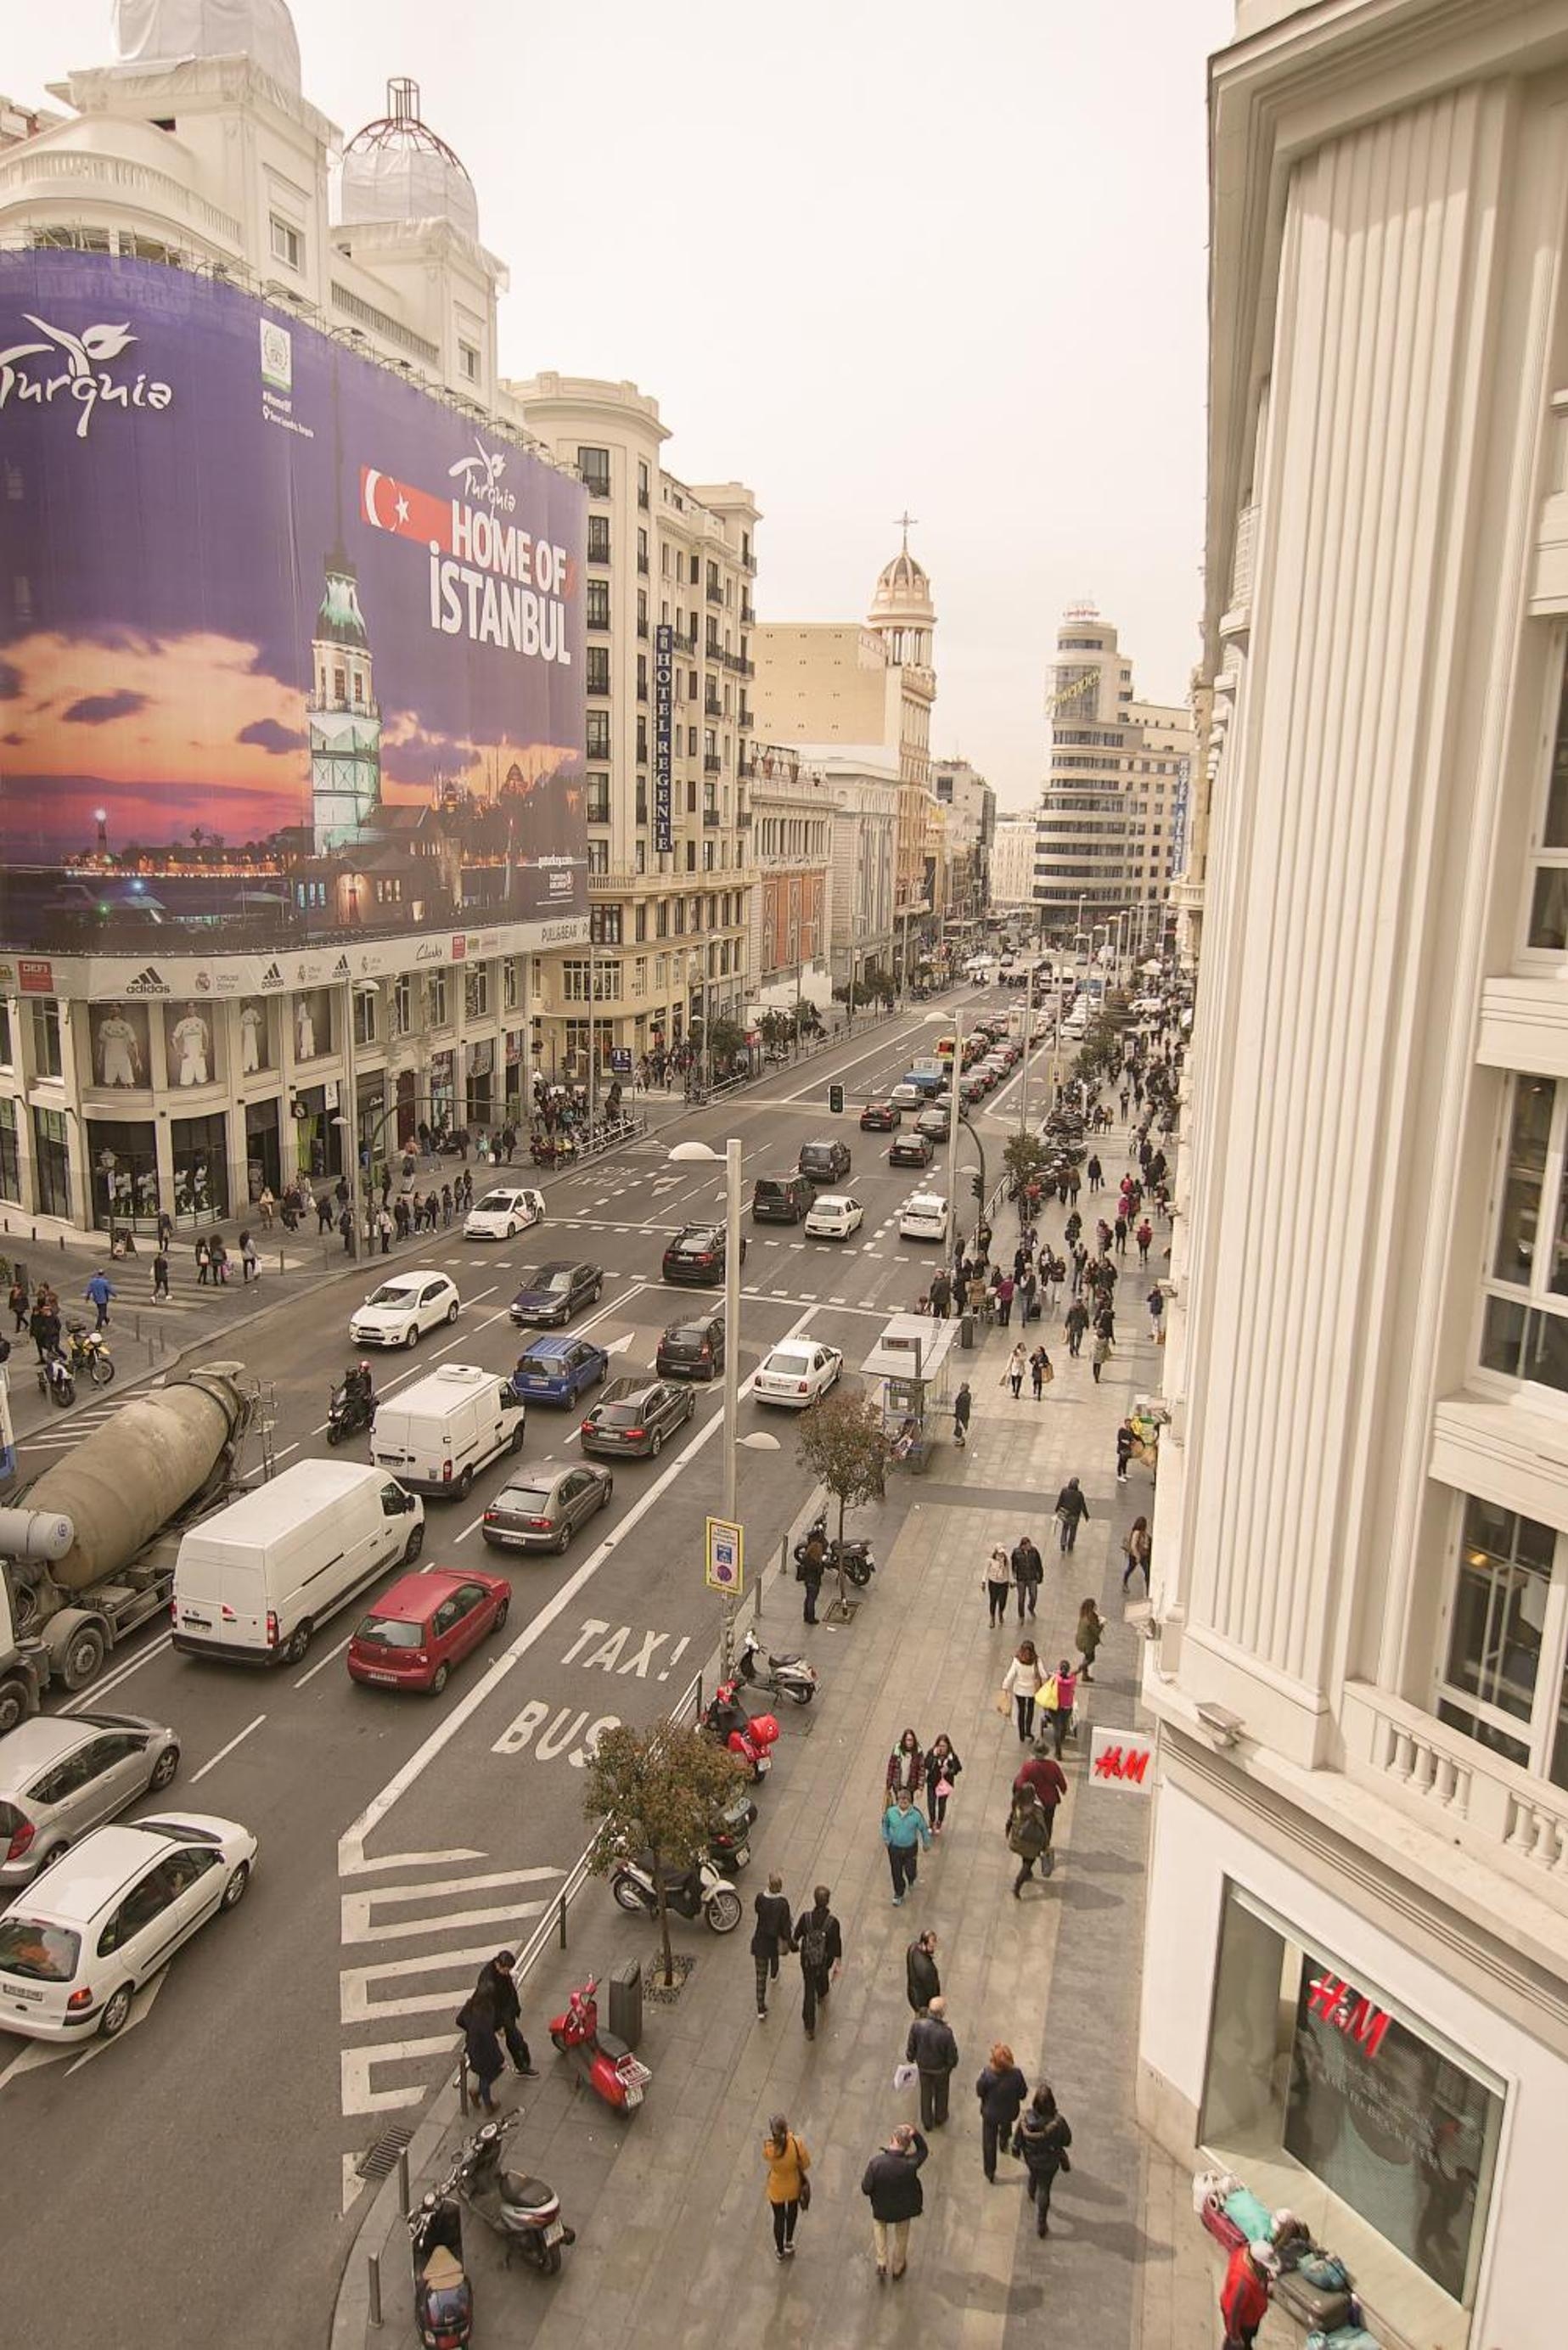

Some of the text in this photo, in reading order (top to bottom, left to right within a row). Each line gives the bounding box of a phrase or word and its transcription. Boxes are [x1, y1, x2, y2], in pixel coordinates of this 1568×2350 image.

[452, 499, 566, 596] HOME OF
[657, 652, 671, 851] HOTEL REGENTE
[126, 983, 171, 994] adidas
[261, 978, 284, 989] adidas
[490, 1700, 622, 1768] BUS
[1094, 1746, 1150, 1784] H&M
[1307, 1971, 1391, 2058] H&M
